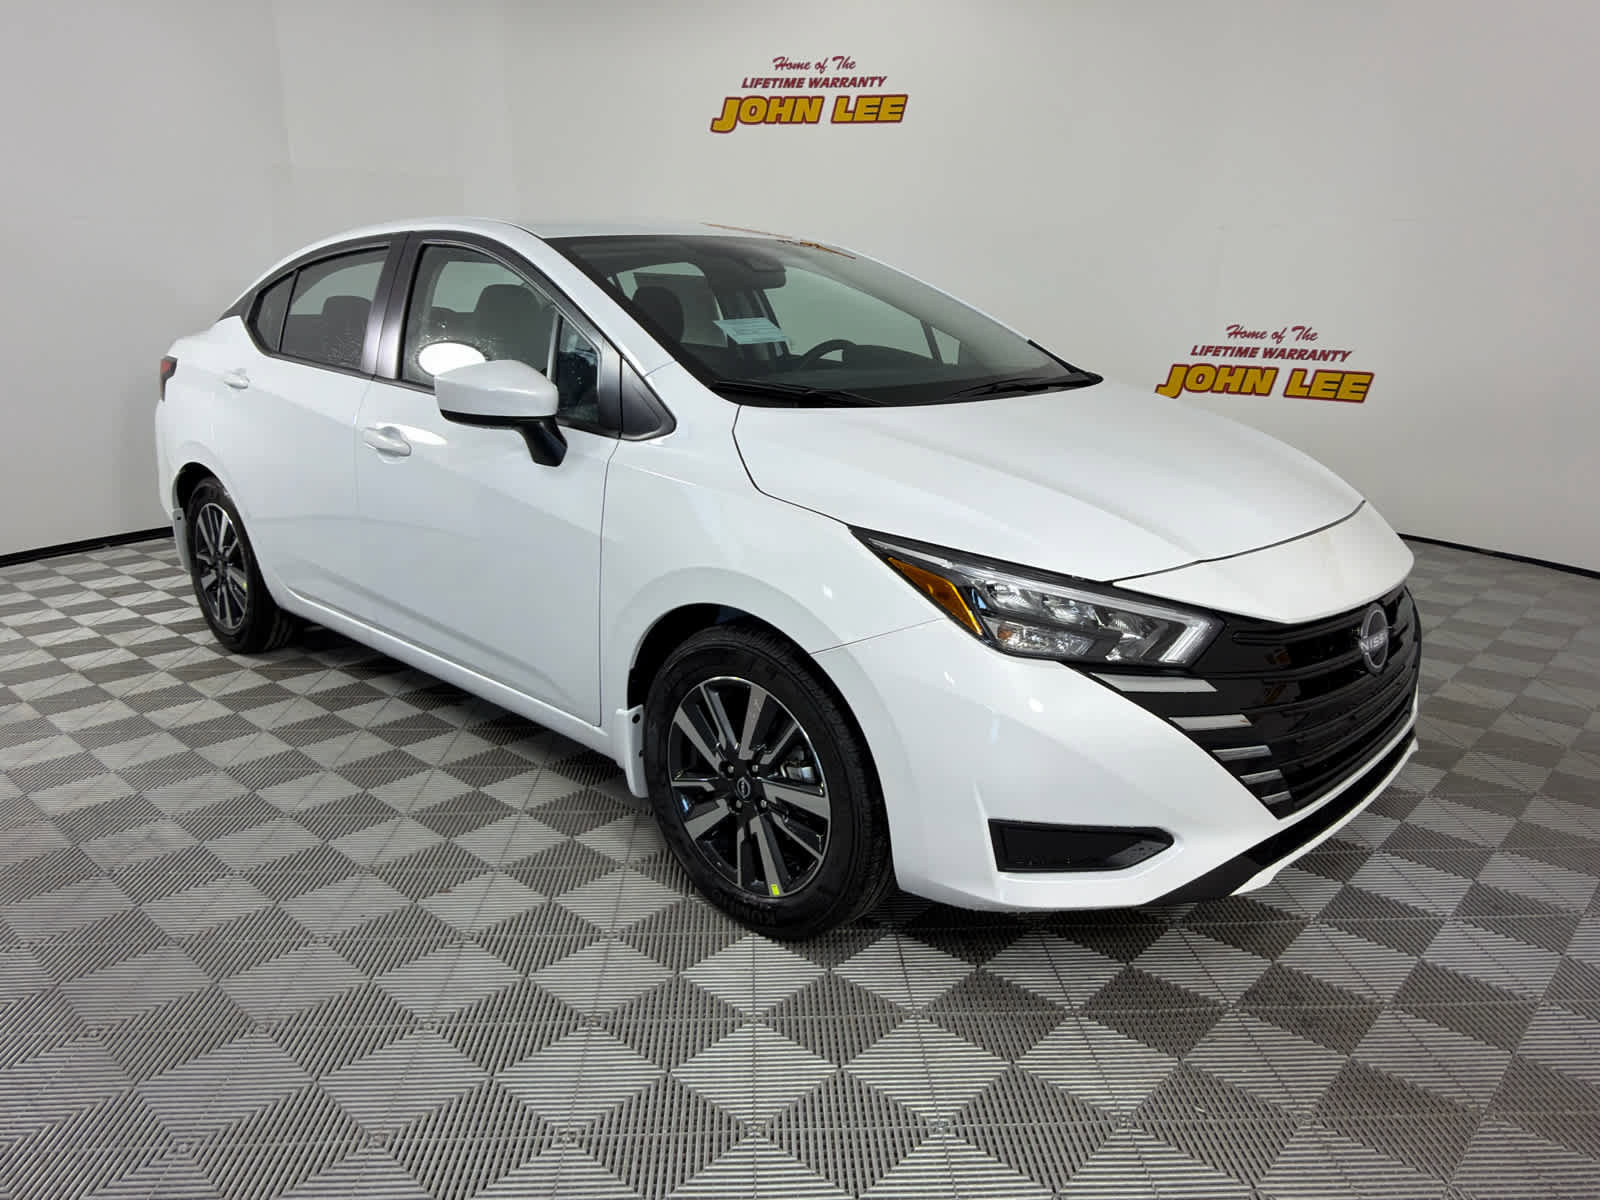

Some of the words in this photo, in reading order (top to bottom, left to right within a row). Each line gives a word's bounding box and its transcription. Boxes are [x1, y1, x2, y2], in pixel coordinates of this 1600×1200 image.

[772, 56, 810, 71] Home
[814, 58, 829, 74] of
[832, 55, 856, 71] The
[741, 77, 805, 88] LIFETIME
[808, 76, 887, 88] WARRANTY
[710, 95, 825, 133] JOHN
[831, 94, 908, 124] LEE
[1226, 324, 1267, 340] Home
[1271, 327, 1287, 344] of
[1291, 325, 1319, 342] The
[1190, 345, 1260, 359] LIFETIME
[1262, 346, 1352, 362] WARRANTY
[1155, 363, 1279, 399] JOHN
[1283, 368, 1375, 403] LEE
